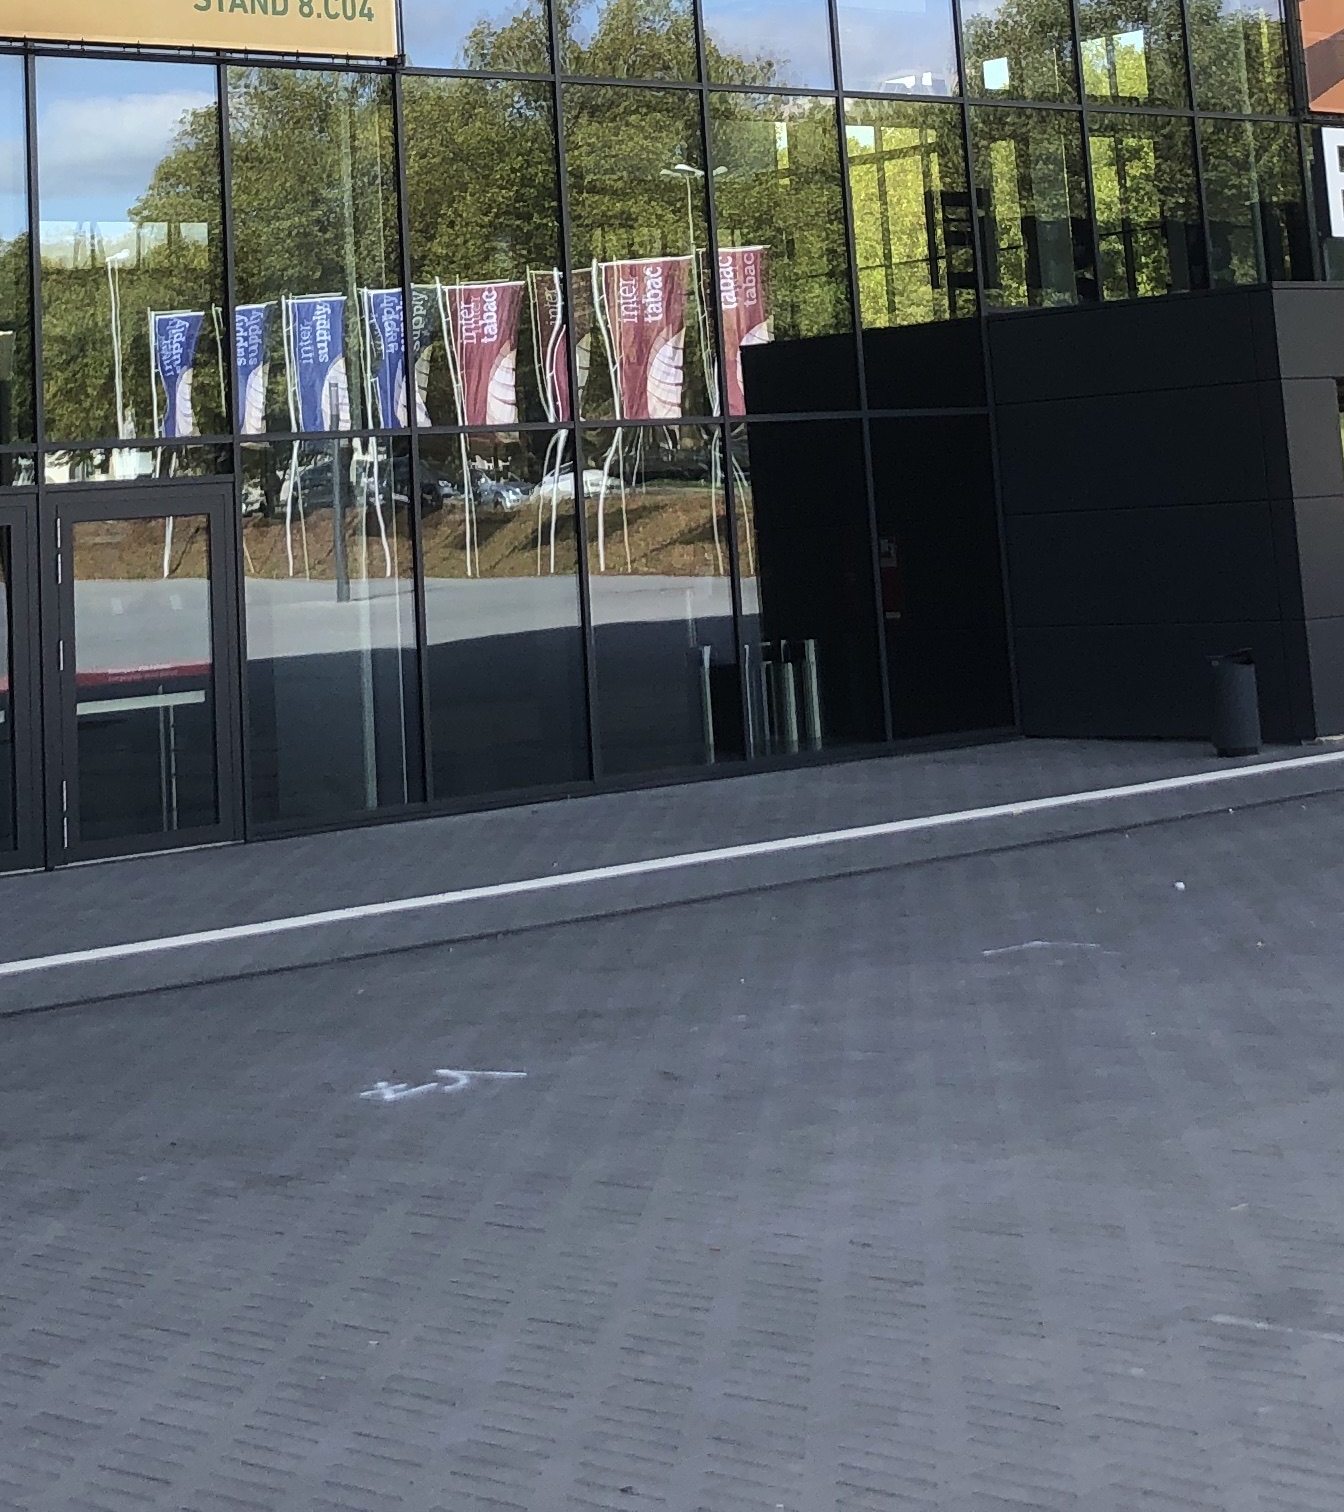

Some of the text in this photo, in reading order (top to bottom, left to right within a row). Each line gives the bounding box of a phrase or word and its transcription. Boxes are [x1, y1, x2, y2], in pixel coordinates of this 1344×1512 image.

[643, 265, 664, 324] tabac
[742, 252, 757, 308] tabac
[298, 318, 315, 364] inter
[312, 301, 332, 363] supply
[481, 286, 498, 344] tabac
